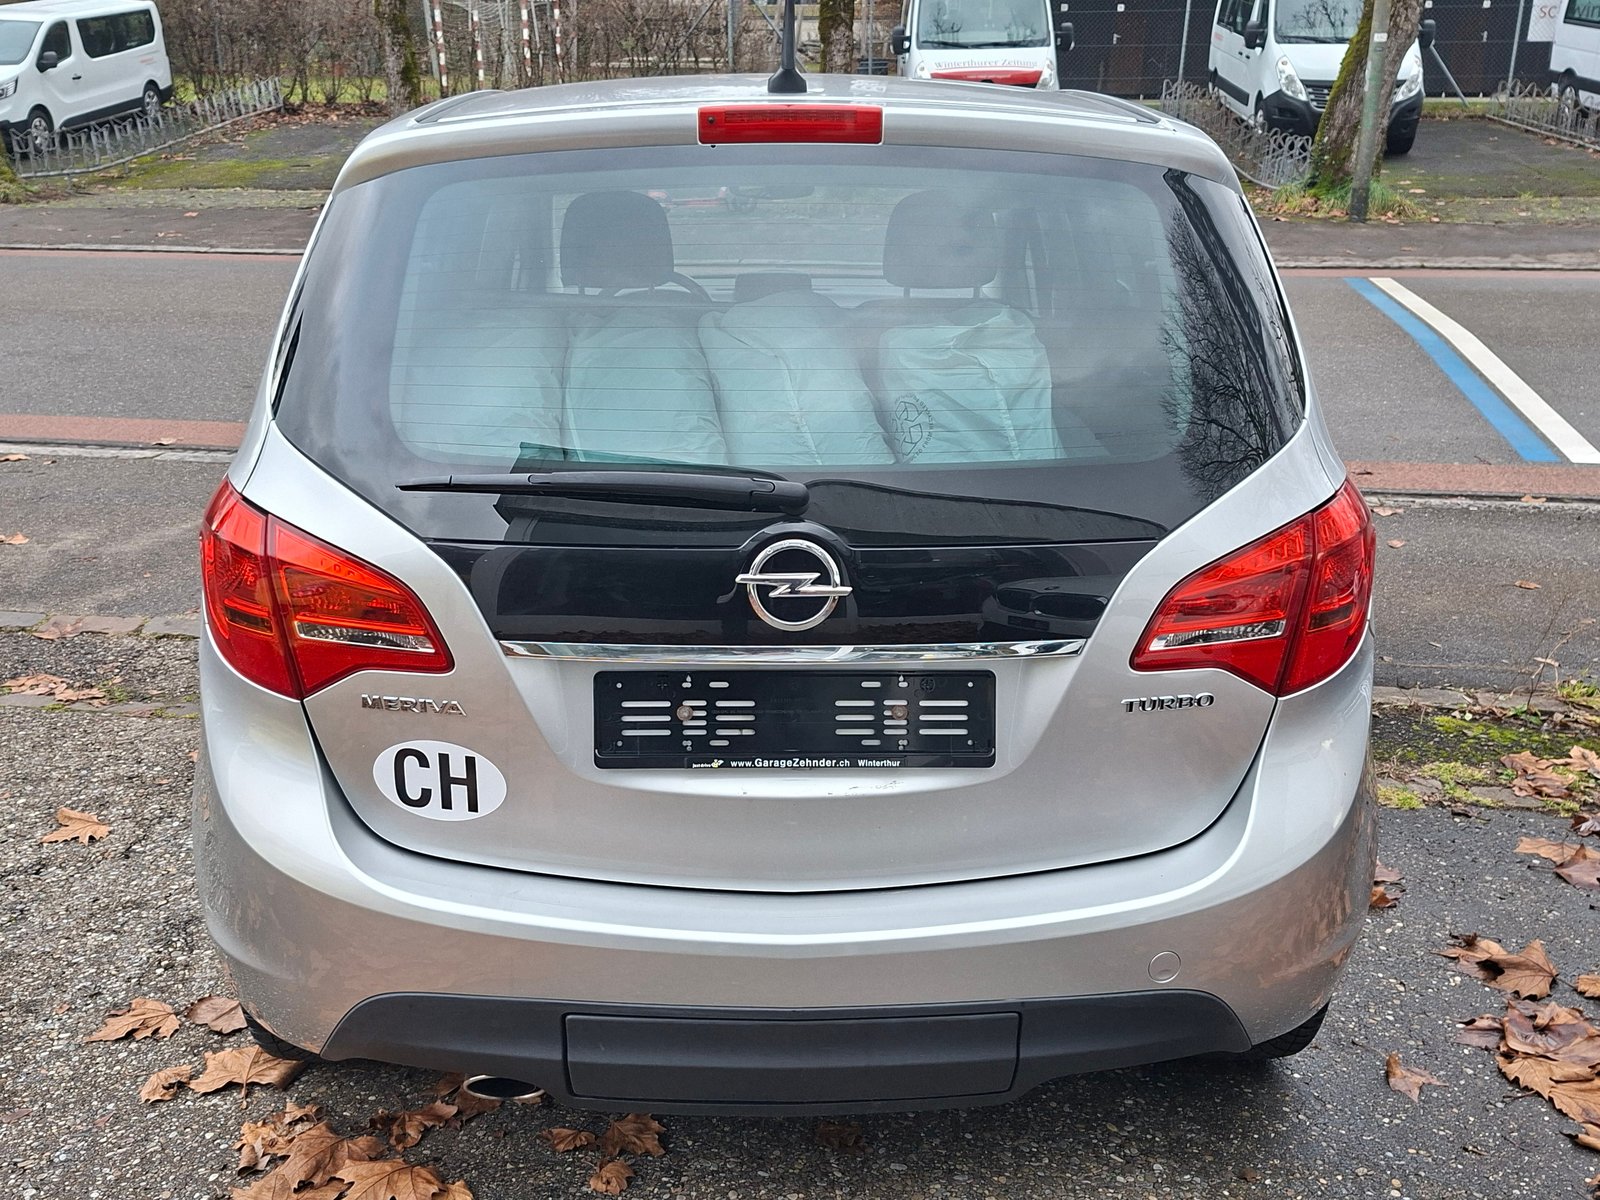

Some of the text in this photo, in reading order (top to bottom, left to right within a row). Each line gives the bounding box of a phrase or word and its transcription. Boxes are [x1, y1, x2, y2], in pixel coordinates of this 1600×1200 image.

[934, 59, 1038, 68] Winterthurer Zeitung
[361, 694, 467, 716] MERIVA
[1121, 692, 1215, 712] TURBO
[730, 758, 900, 768] www.GarageZehnder.ch Winterthur
[394, 748, 478, 813] CH
